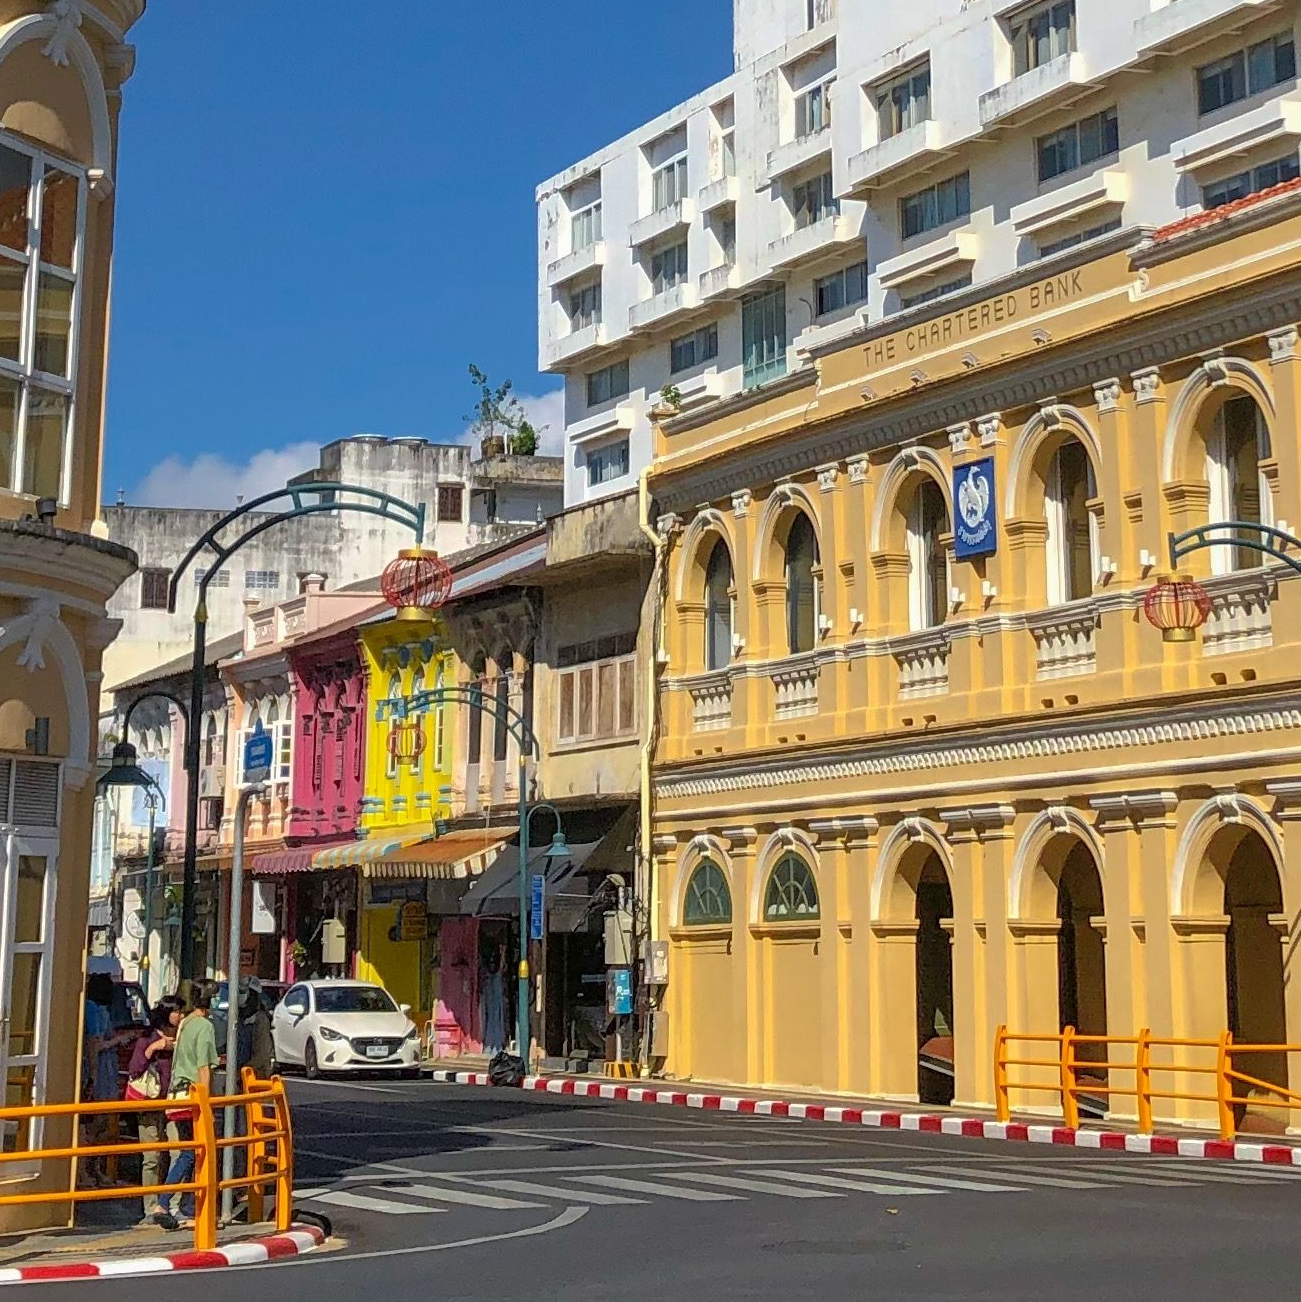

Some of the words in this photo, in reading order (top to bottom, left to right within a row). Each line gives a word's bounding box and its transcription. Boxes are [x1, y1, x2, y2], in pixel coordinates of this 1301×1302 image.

[862, 338, 895, 368] THE
[905, 295, 1018, 352] CHARTERED
[1030, 269, 1083, 309] BANK
